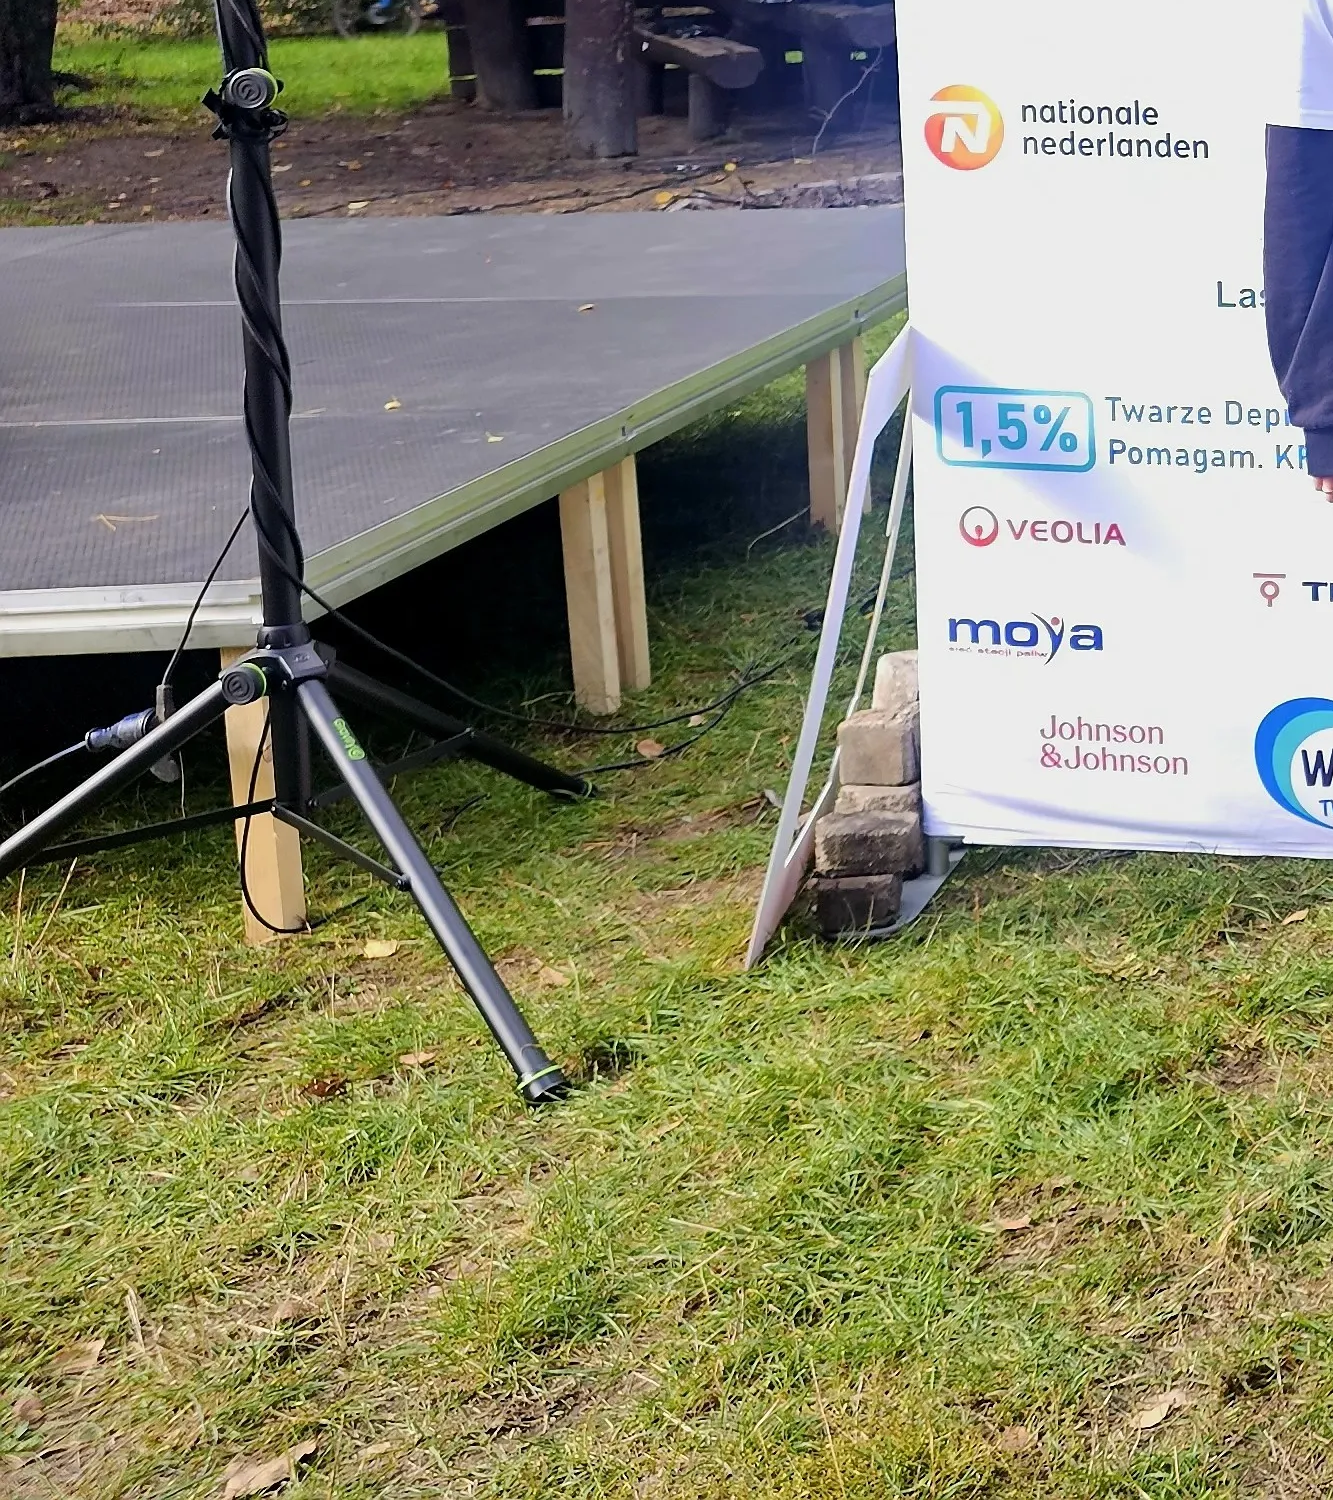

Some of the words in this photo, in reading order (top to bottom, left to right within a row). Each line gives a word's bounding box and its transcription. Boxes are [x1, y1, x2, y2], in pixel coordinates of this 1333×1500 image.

[1021, 98, 1159, 127] nationale
[1022, 131, 1210, 160] nederlanden
[1105, 396, 1212, 425] Twarze
[955, 400, 1078, 460] 1,5%
[1108, 439, 1264, 474] Pomagam.
[1006, 518, 1127, 547] VEOLIA
[948, 612, 1104, 666] moya
[1040, 715, 1165, 745] Johnson
[1040, 743, 1189, 776] &Johnson
